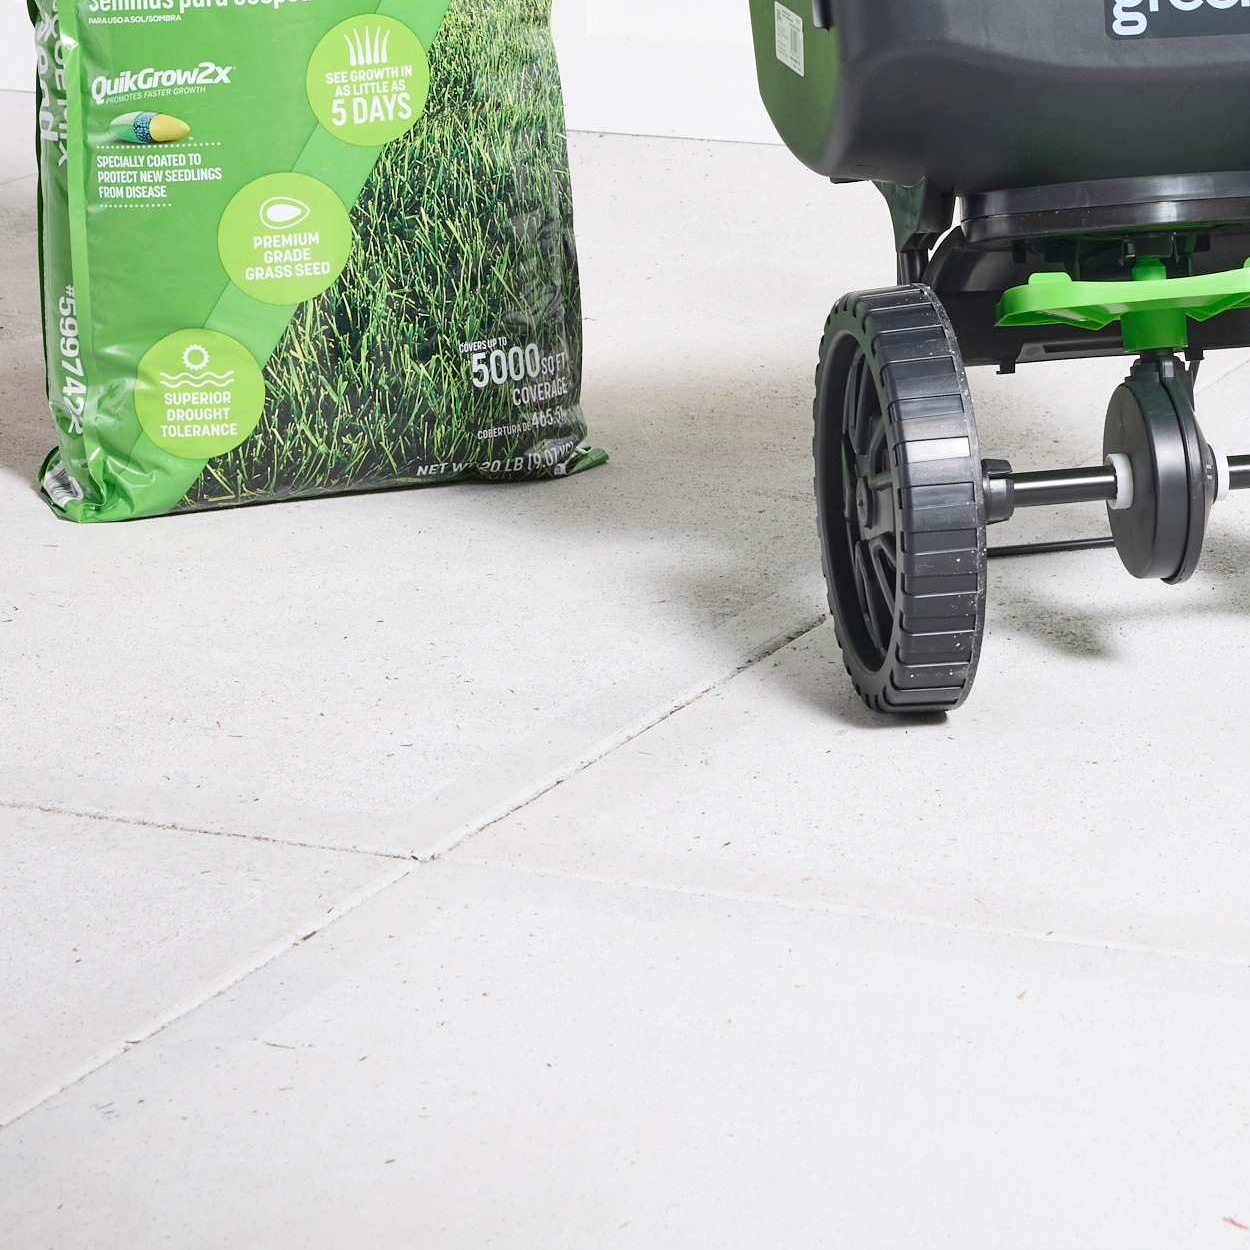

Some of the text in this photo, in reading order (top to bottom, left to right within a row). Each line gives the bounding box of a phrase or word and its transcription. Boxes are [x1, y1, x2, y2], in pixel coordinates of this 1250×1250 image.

[88, 14, 182, 25] PARA USO A SOL/SOMBRA
[325, 65, 413, 85] SEE GROWTH IN
[105, 86, 207, 105] PROMOTES FASTER GROWTH
[335, 79, 406, 98] AS LITTLE AS
[331, 91, 412, 127] 5 DAYS
[96, 153, 201, 168] SPECIALLY COATED TO
[97, 167, 222, 183] PROTECT NEW SEEDLINGS
[98, 185, 167, 199] FROM DISEASE
[253, 231, 320, 250] PREMIUM
[263, 247, 311, 264] GRADE
[245, 261, 331, 281] GRASS SEED
[458, 336, 508, 354] COVERS UP TO
[471, 342, 566, 388] 5000 SQ FT
[164, 391, 232, 406] SUPERIOR
[512, 376, 568, 406] COVERAGE
[166, 407, 230, 422] DROUGHT
[160, 423, 238, 438] TOLERANCE
[477, 424, 522, 440] COBERTURA
[522, 421, 531, 432] DE
[416, 462, 448, 476] NET
[504, 456, 524, 472] LB
